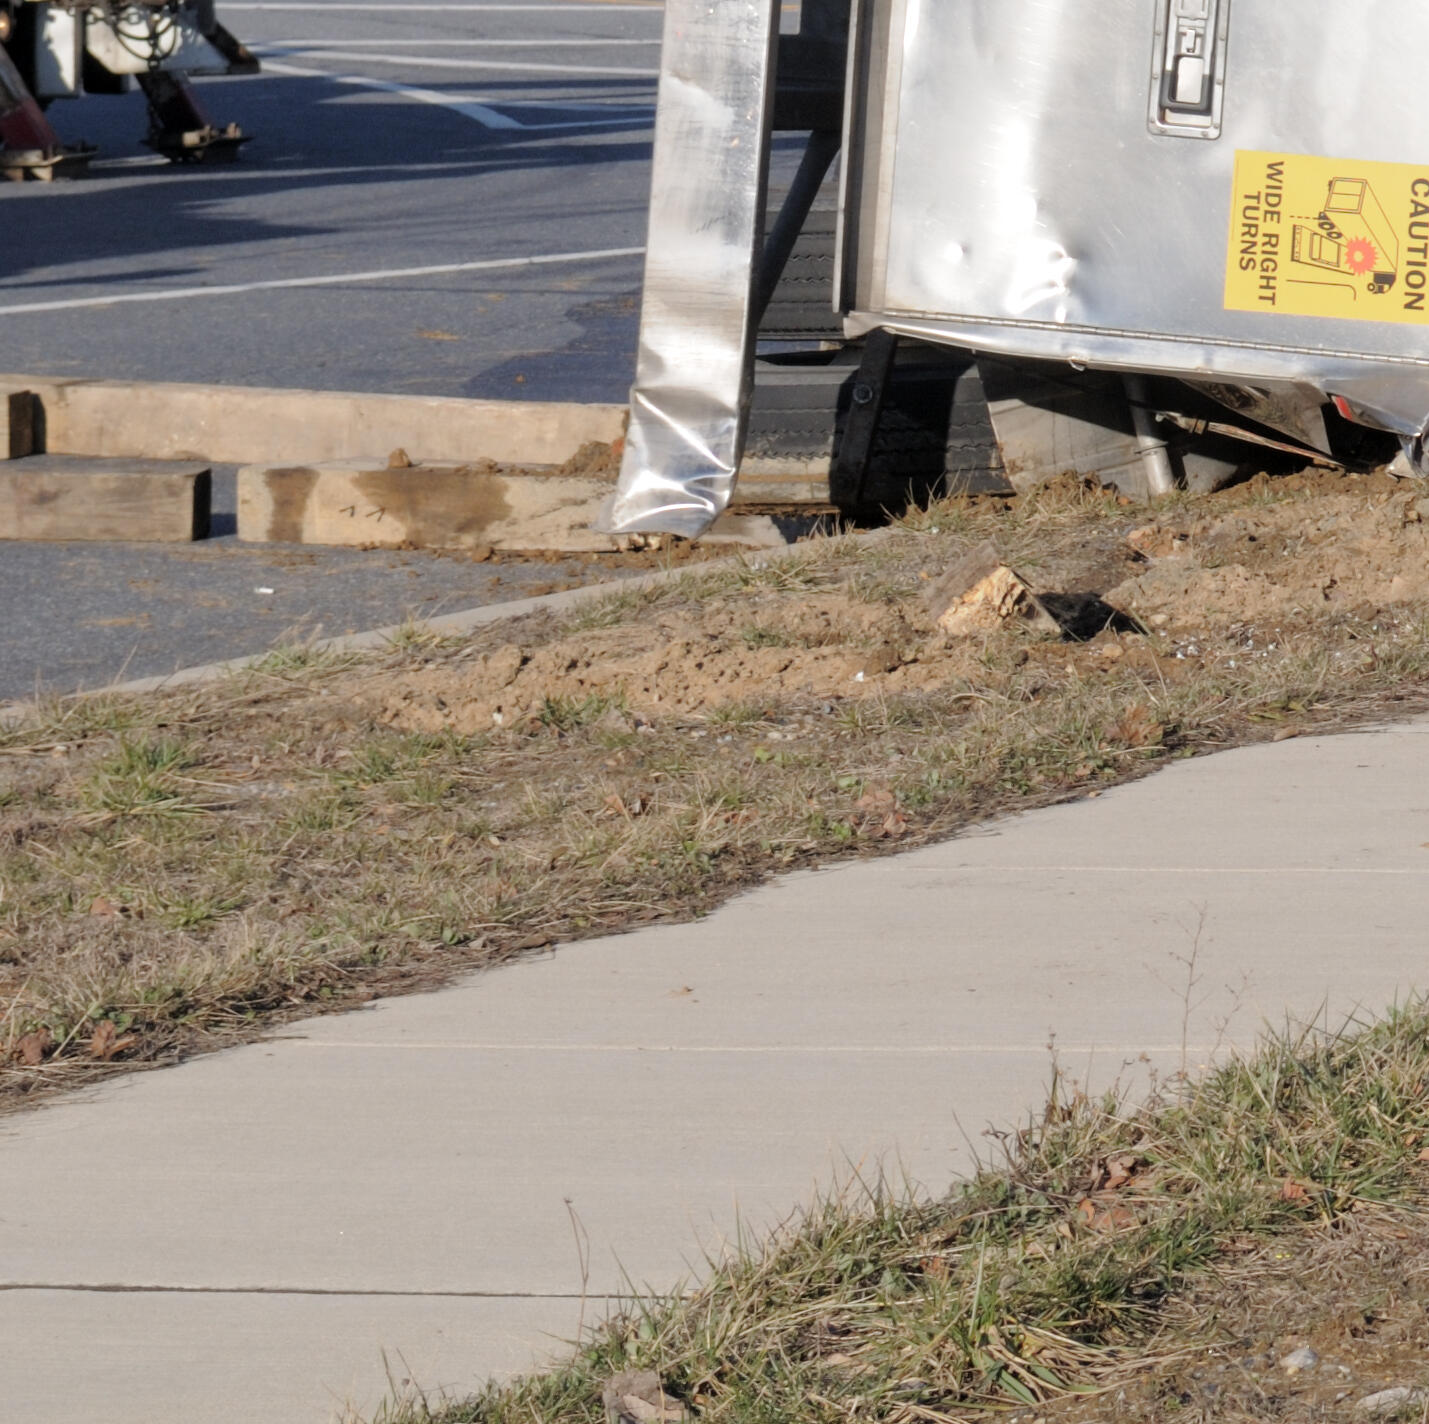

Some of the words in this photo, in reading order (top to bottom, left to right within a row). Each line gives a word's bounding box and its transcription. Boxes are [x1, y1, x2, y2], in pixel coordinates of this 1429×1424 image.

[1263, 161, 1285, 224] WIDE
[1239, 191, 1261, 271] TURNS
[1258, 232, 1280, 306] RIGHT
